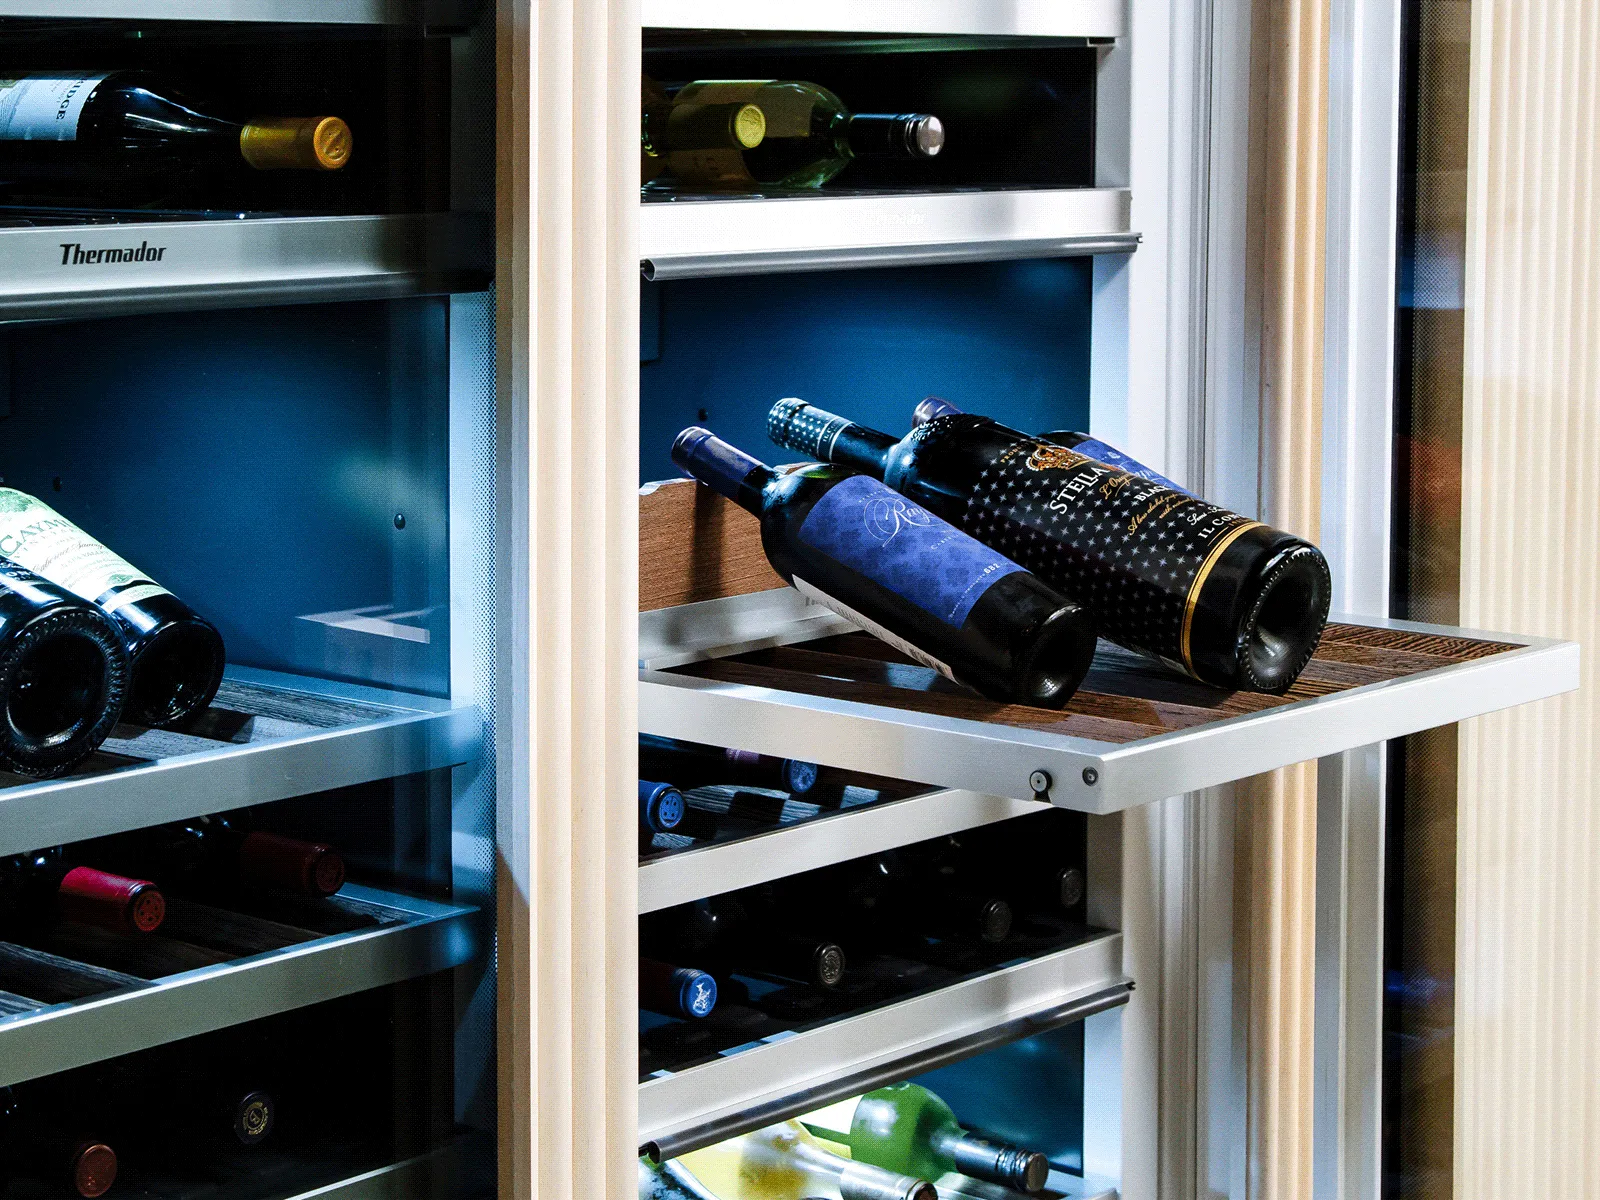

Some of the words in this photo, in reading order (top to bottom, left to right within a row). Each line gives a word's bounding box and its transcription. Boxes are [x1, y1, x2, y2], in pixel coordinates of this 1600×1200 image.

[60, 241, 166, 265] Thermador
[1049, 466, 1111, 515] STELLA
[983, 562, 1001, 575] 682
